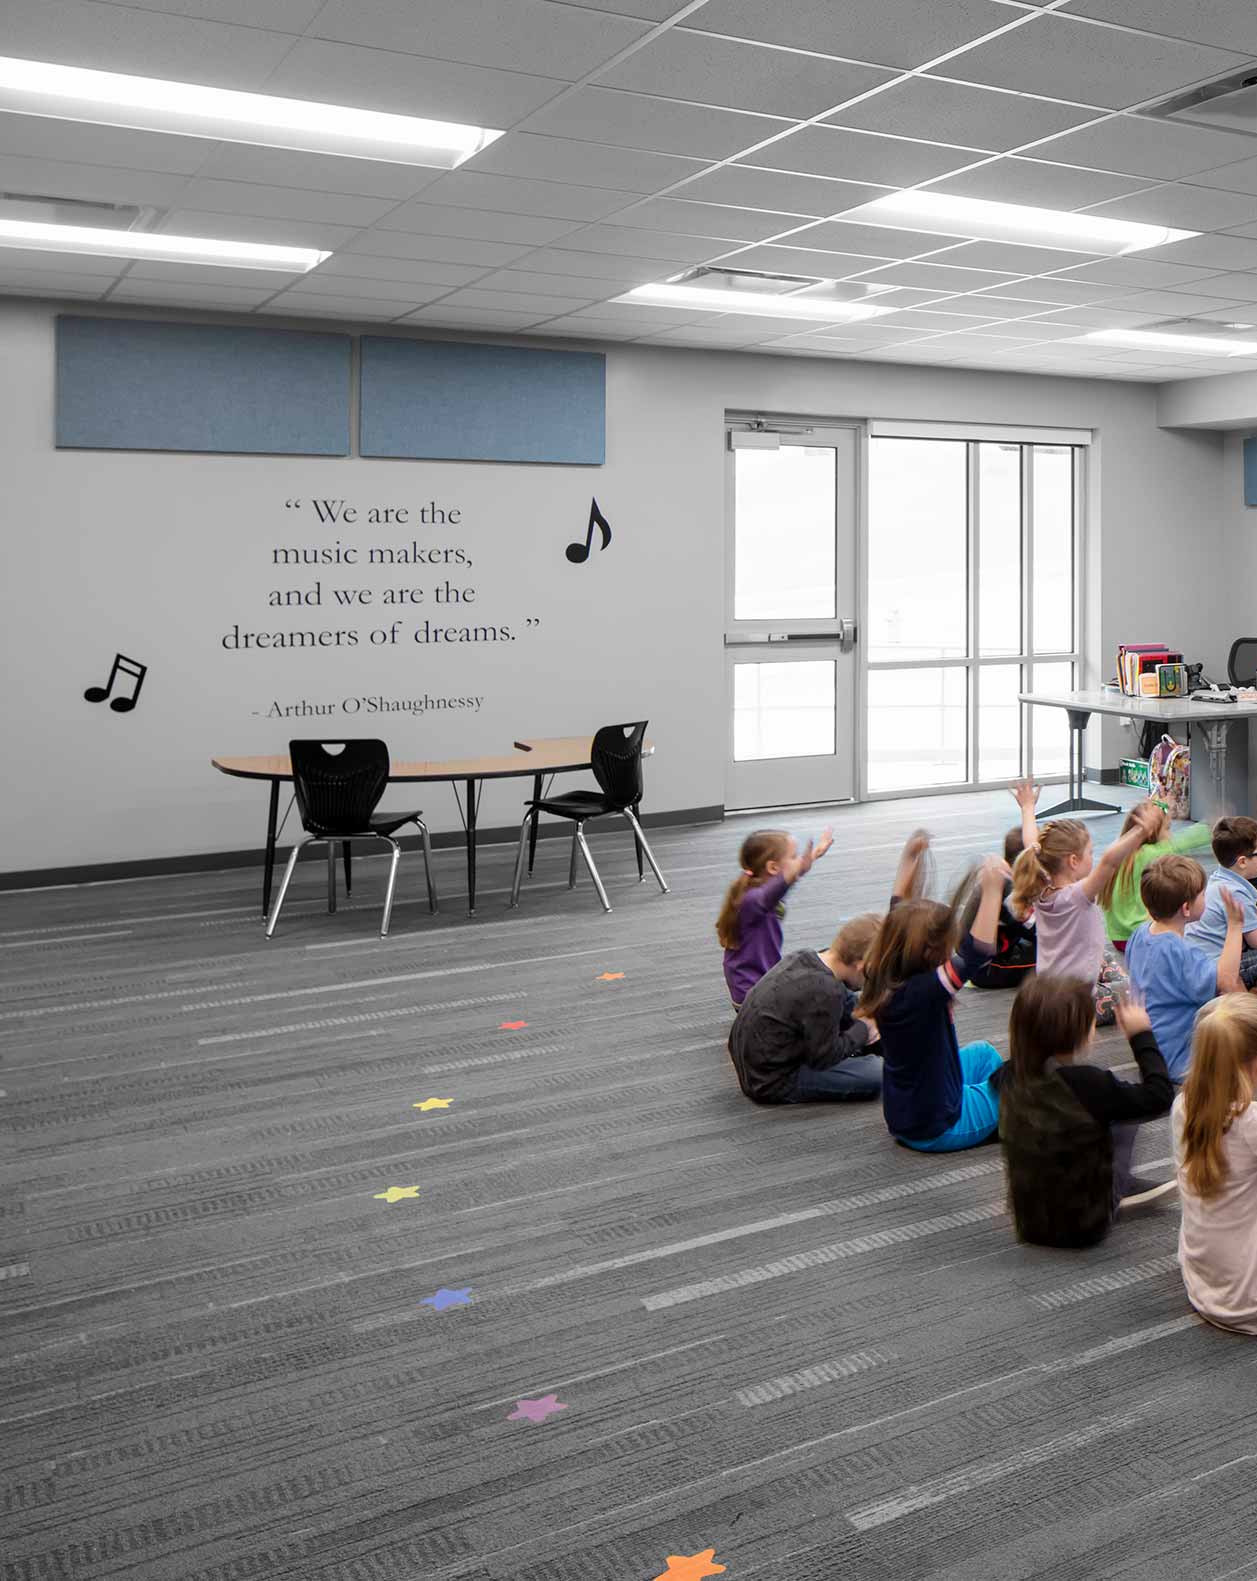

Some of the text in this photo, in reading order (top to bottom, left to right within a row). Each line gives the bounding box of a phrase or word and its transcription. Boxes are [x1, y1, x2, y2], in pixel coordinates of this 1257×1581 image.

[369, 509, 408, 523] are
[420, 502, 460, 524] the
[273, 541, 472, 567] music makers,
[269, 581, 475, 606] and we are the
[222, 625, 358, 649] dreamers
[370, 621, 402, 644] of
[267, 699, 336, 718] Arthur
[342, 695, 483, 715] O’Shaughnessy
